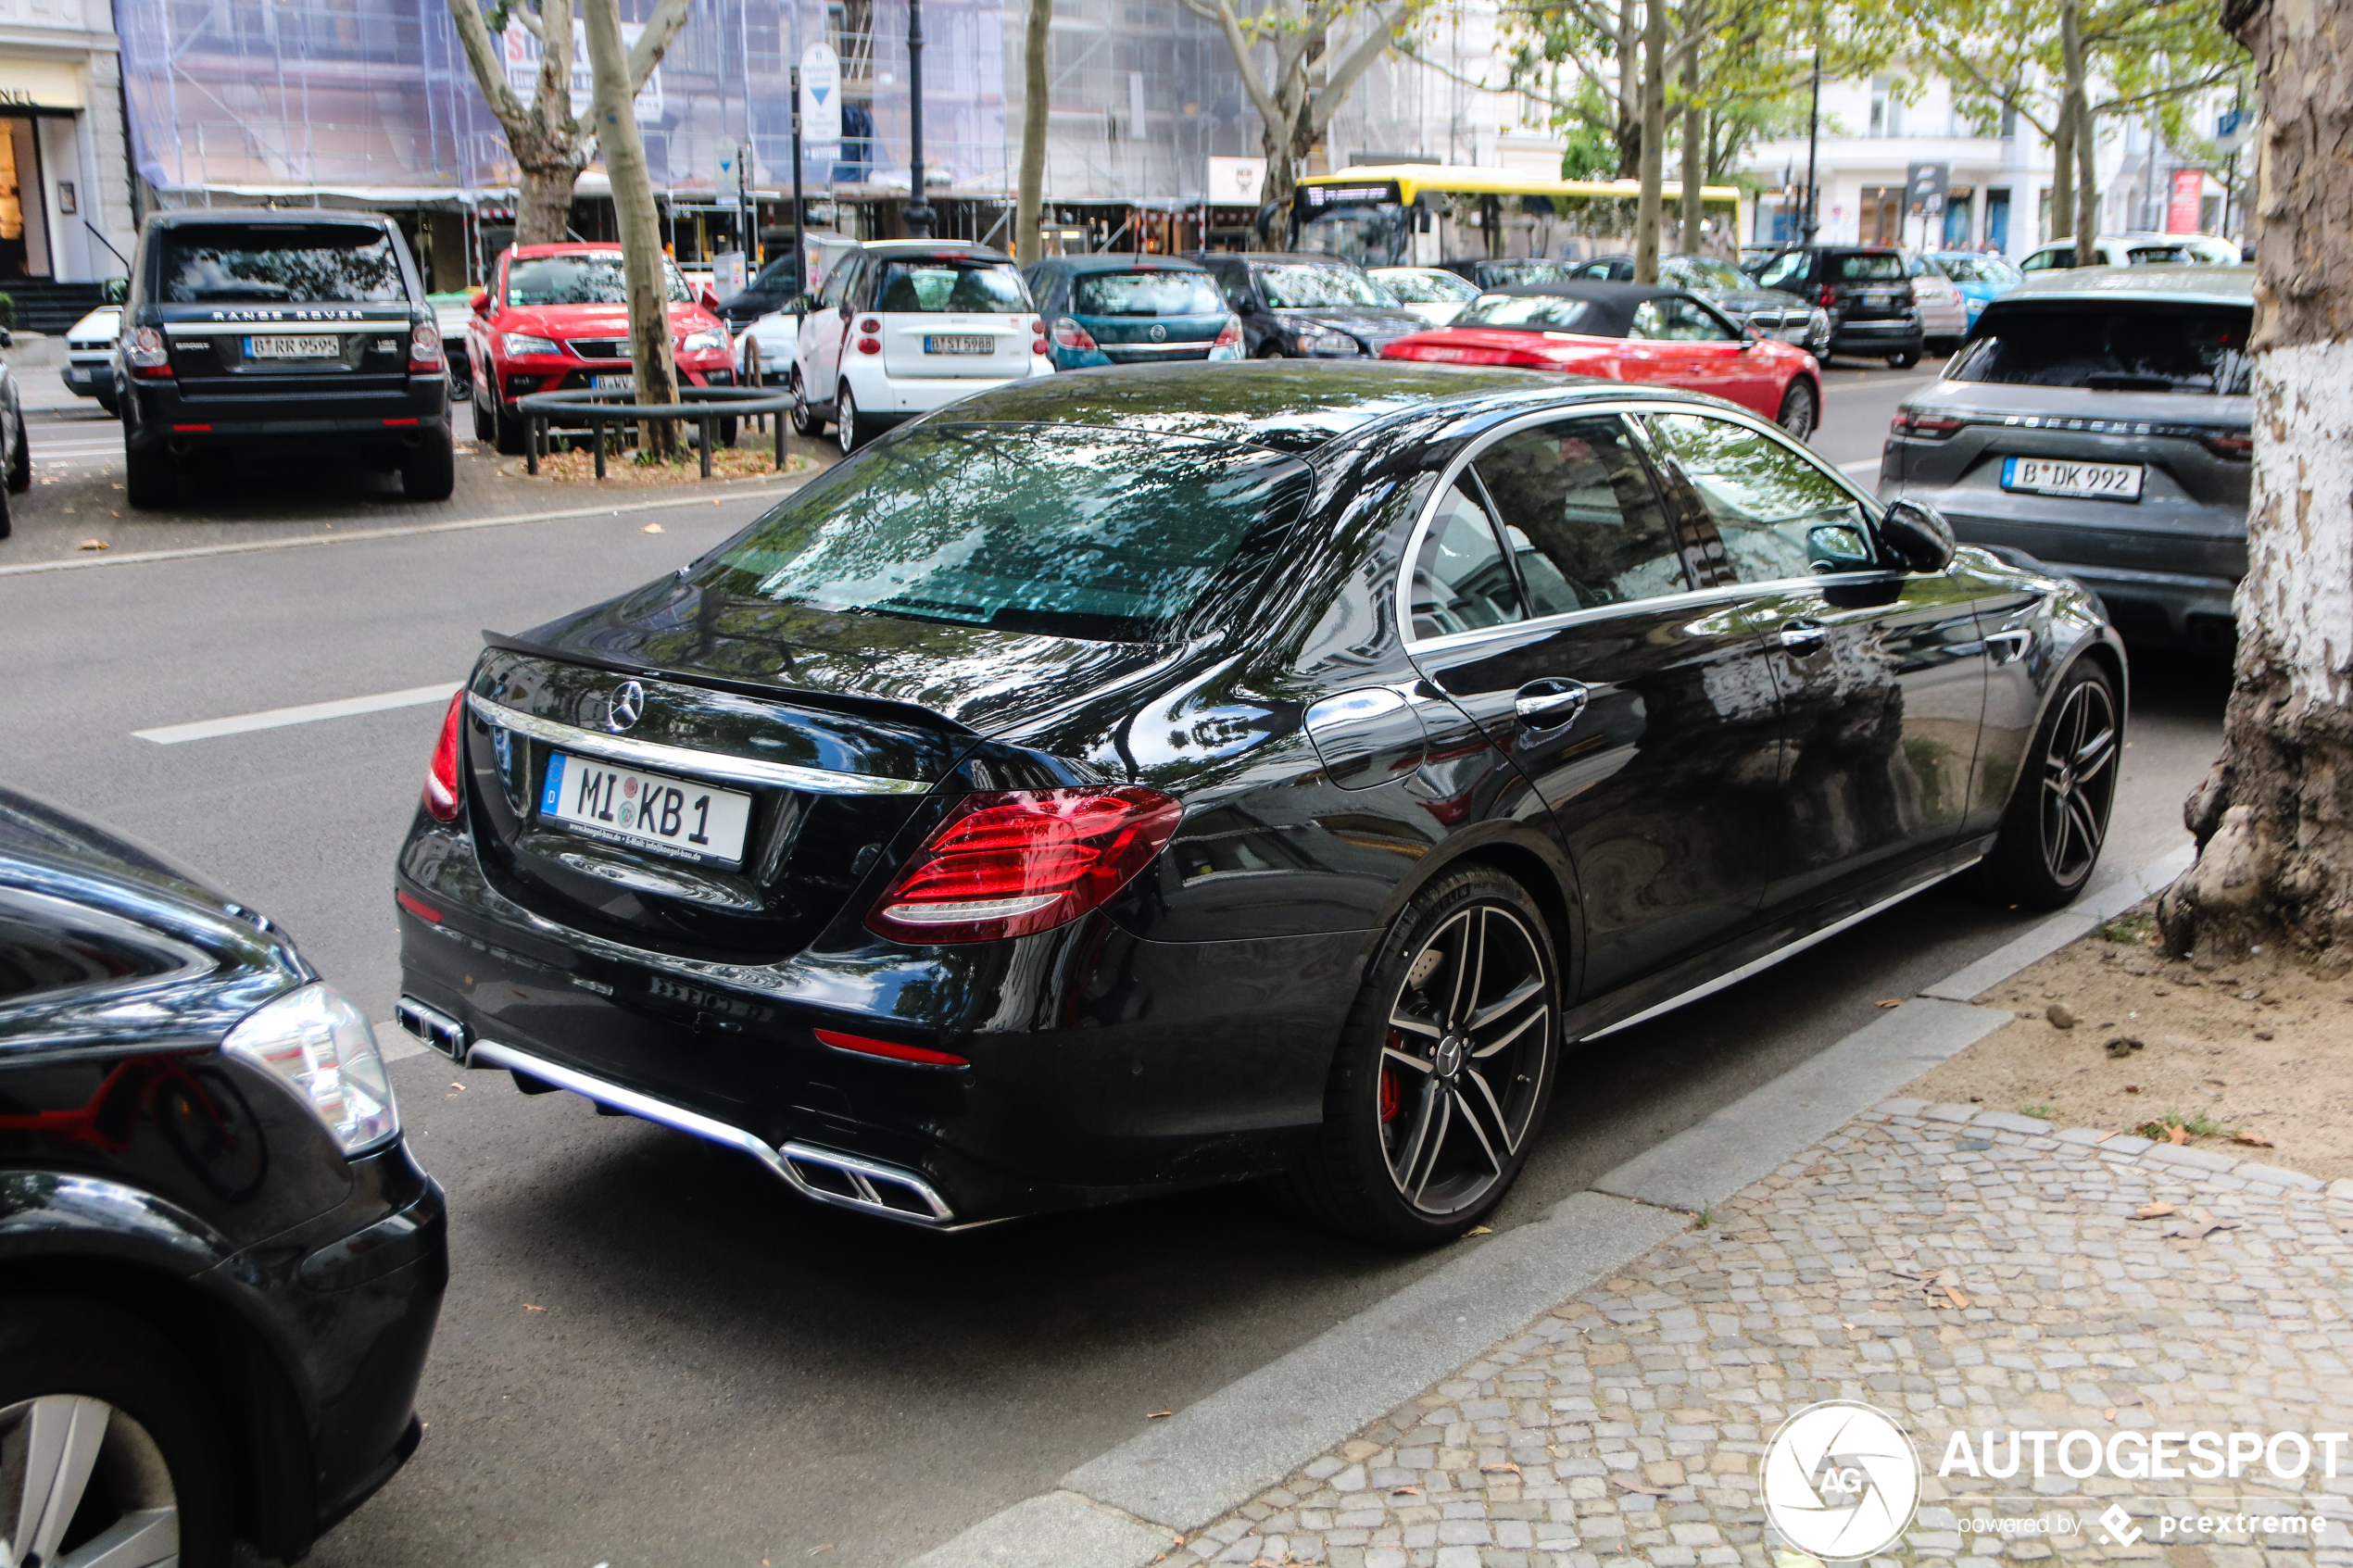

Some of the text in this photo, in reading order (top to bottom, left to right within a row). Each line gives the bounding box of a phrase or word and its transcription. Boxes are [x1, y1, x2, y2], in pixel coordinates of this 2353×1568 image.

[211, 309, 363, 321] RANGE ROVER
[175, 342, 211, 351] SPORT
[255, 339, 338, 354] B RR 9595
[2023, 463, 2130, 492] B DK 992
[547, 789, 556, 804] D
[577, 768, 711, 846] MI KB 1
[569, 822, 701, 861] www.koegel-bau.de E-Mail: info@koegel-bau.de
